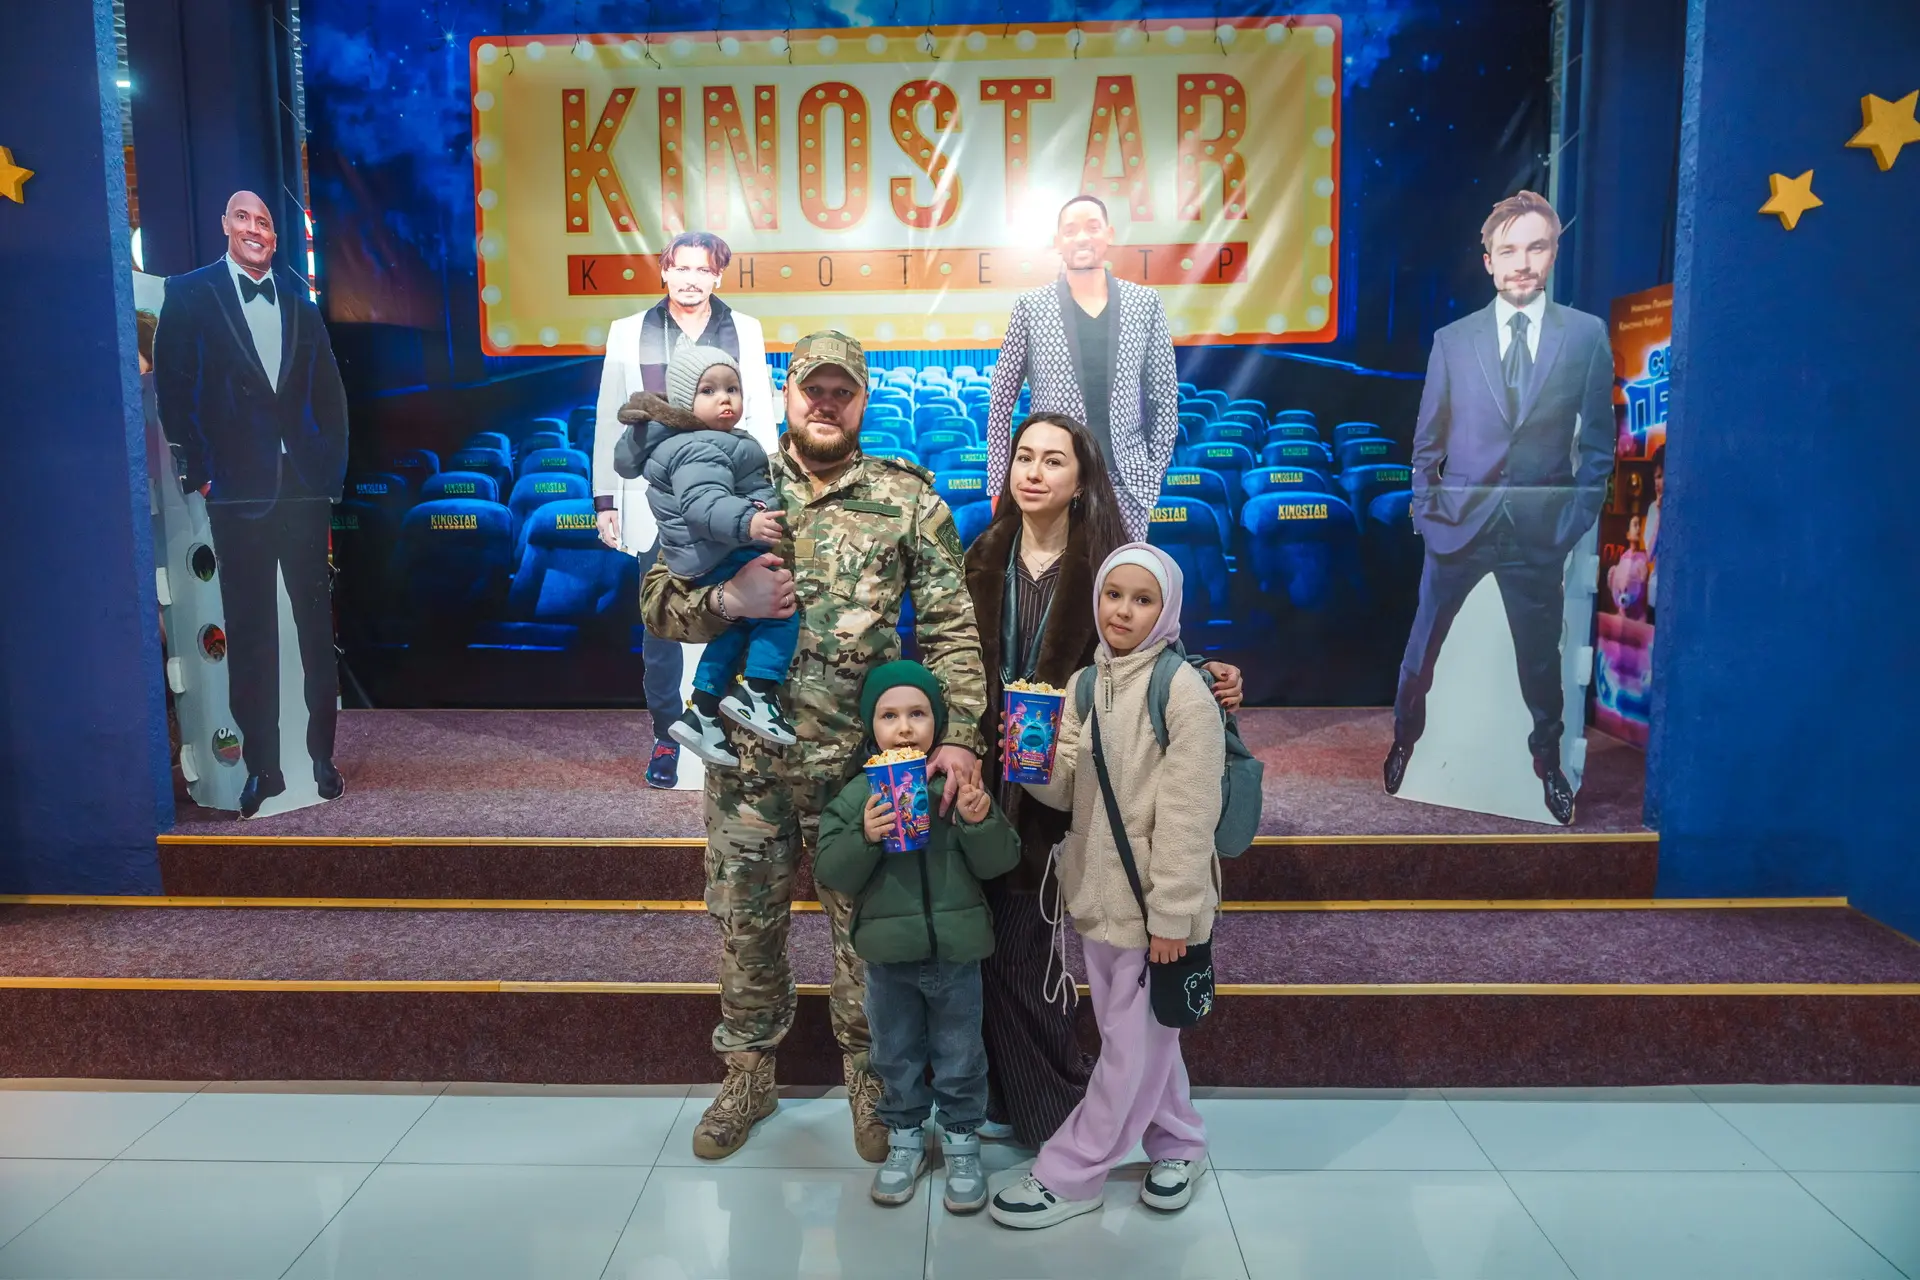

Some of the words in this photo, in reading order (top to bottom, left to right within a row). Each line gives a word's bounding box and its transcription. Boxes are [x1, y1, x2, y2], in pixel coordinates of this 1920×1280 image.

[561, 73, 1250, 234] KINOSTAR
[1166, 474, 1200, 484] KINOSTAR
[1271, 472, 1304, 482] KINOSTAR
[1149, 507, 1187, 520] NOSTAR
[1278, 504, 1328, 518] KINOSTAR
[430, 514, 477, 527] KINOSTAR
[556, 514, 598, 527] KINOSTA
